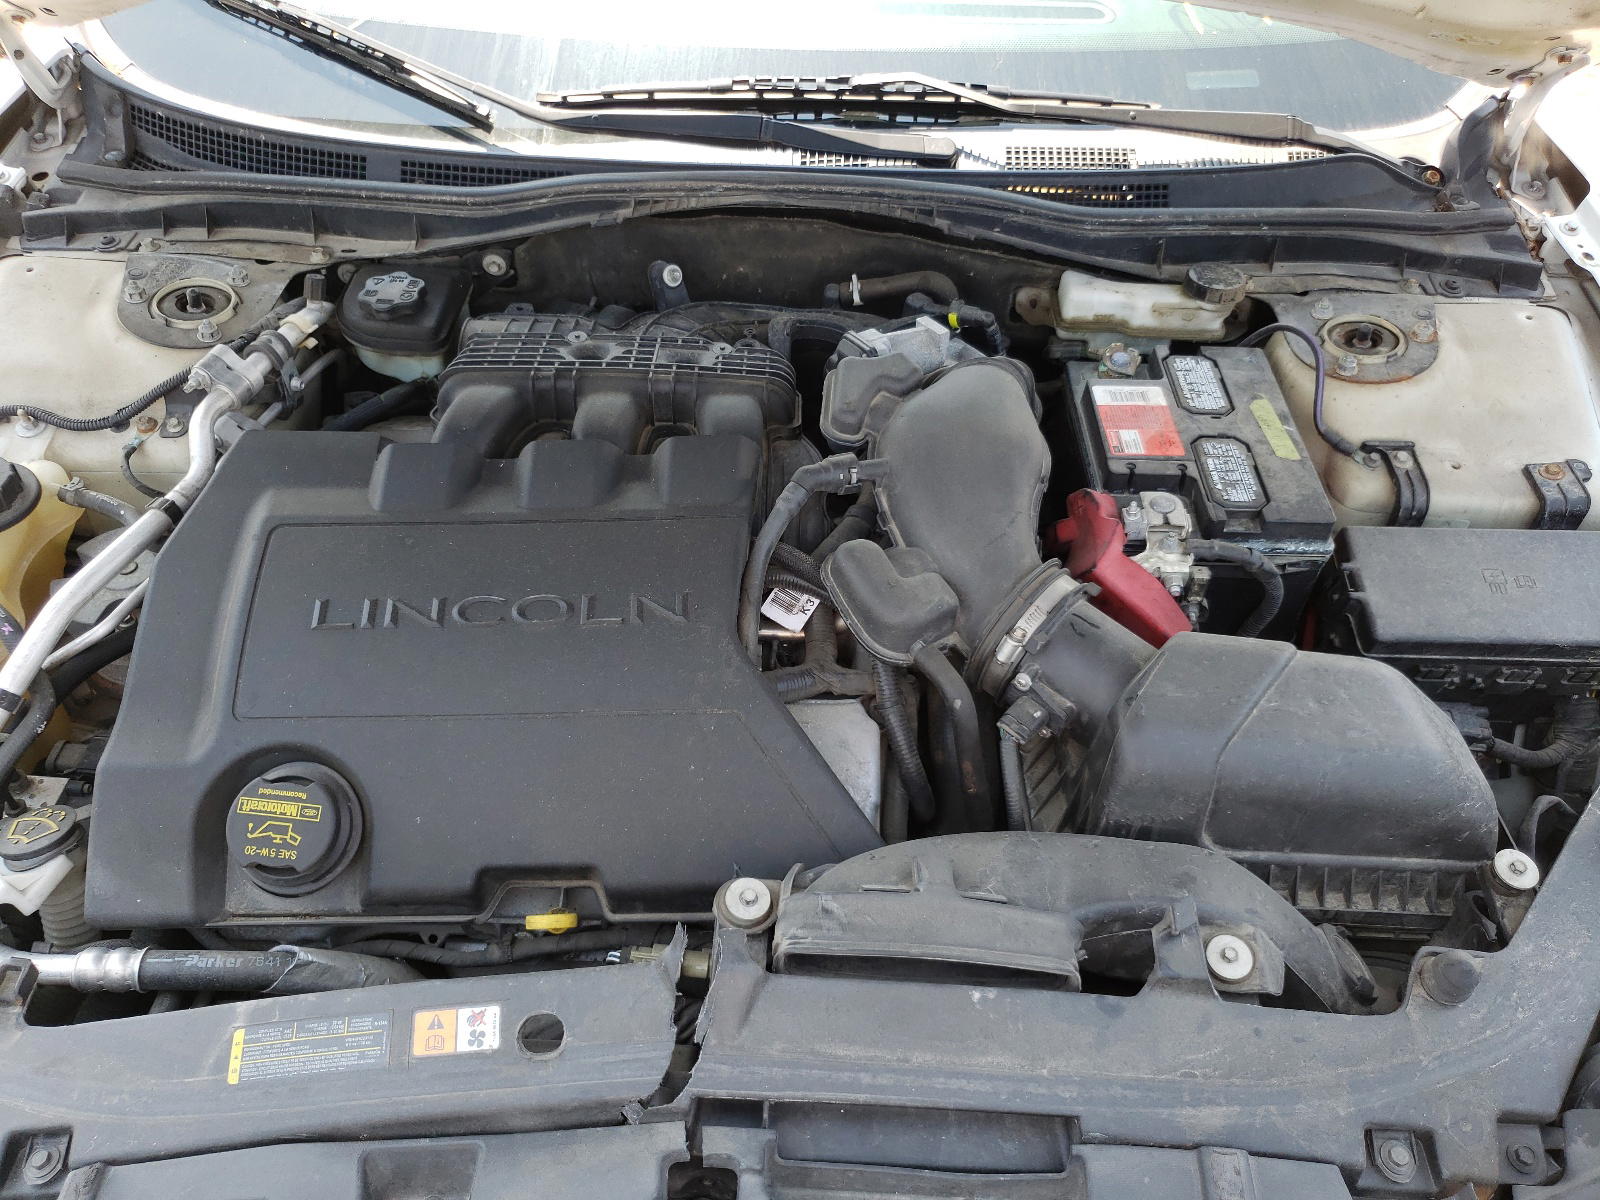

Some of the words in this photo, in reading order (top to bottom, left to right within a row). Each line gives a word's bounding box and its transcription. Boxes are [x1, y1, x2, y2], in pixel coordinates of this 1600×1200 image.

[311, 593, 692, 630] LINCOLN
[258, 787, 307, 799] Recommended
[241, 799, 299, 817] Motorcraft
[277, 849, 297, 860] SAE
[175, 954, 244, 968] Parker
